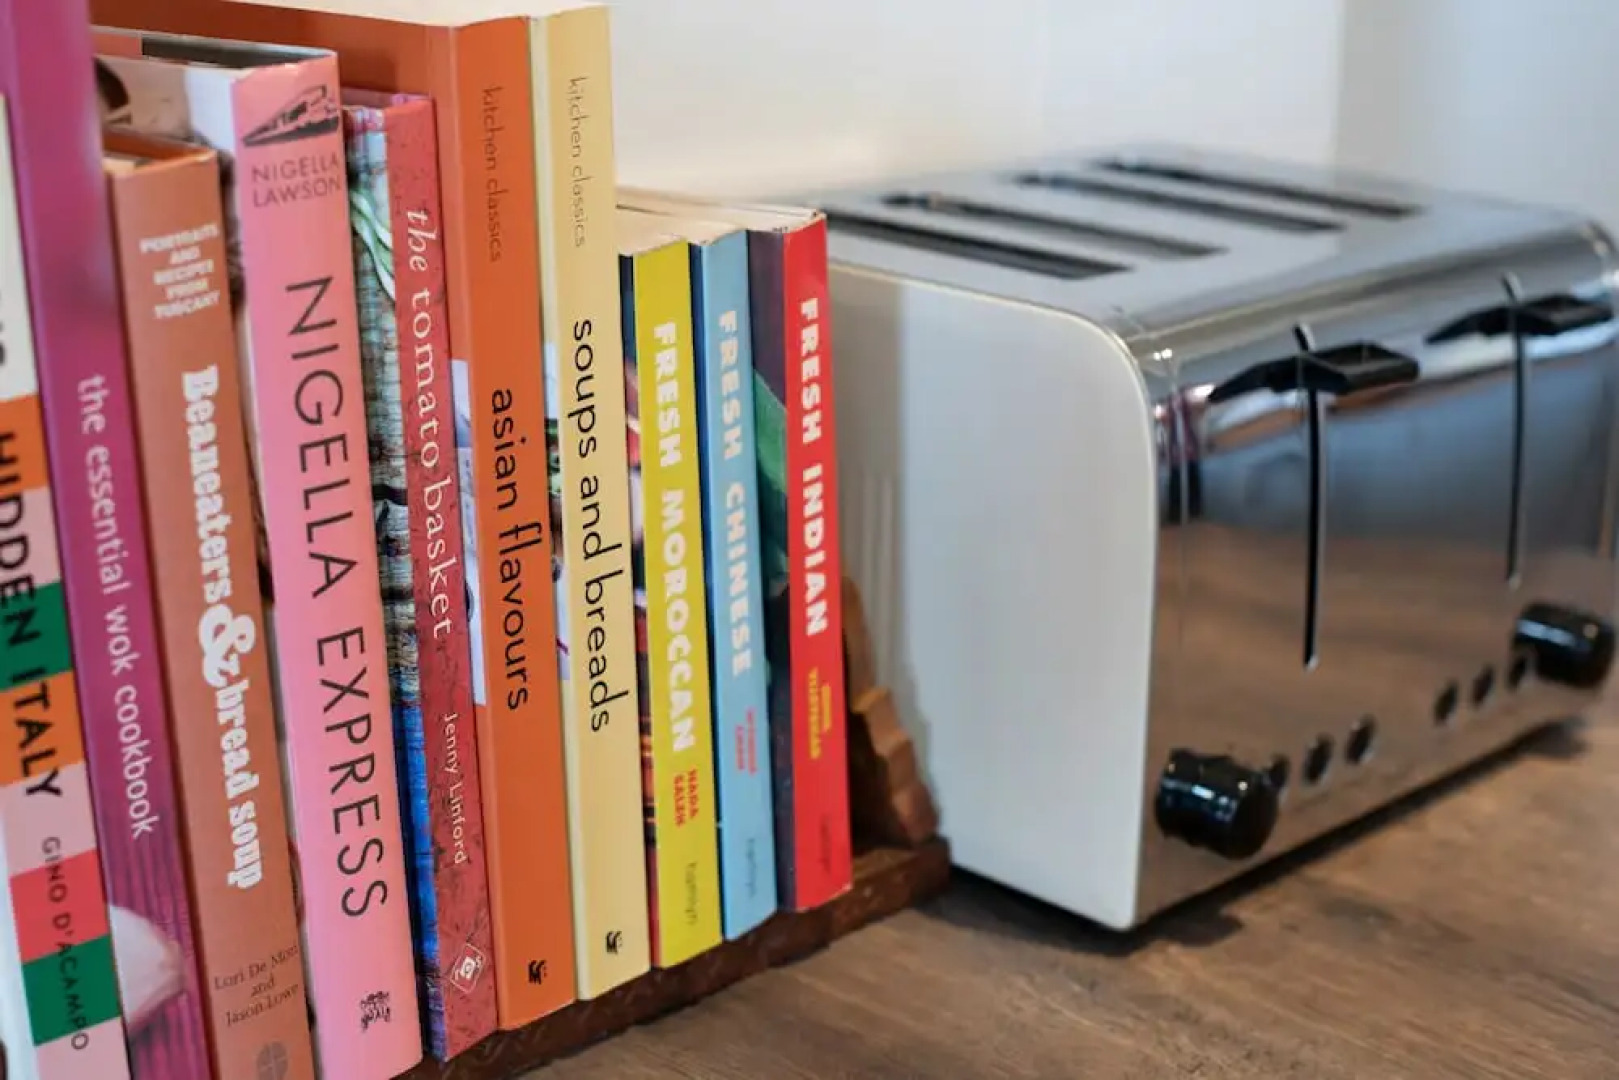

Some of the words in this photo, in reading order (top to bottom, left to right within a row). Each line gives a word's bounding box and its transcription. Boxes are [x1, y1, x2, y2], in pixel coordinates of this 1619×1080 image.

[251, 152, 339, 182] NIGELLA
[481, 85, 504, 171] kitchen
[568, 76, 588, 158] kitchen
[253, 174, 341, 208] LAWSON
[406, 207, 437, 272] the
[77, 374, 110, 434] the
[286, 276, 358, 598] NIGELLA
[412, 287, 440, 469] tomato
[567, 319, 598, 459] soups
[654, 322, 682, 467] FRESH
[718, 310, 743, 459] FRESH
[800, 298, 823, 444] FRESH
[182, 364, 232, 604] Beaneaters
[491, 388, 527, 511] asian
[580, 476, 622, 560] and
[86, 445, 131, 595] essential
[423, 476, 456, 638] basket
[725, 483, 751, 678] CHINESE
[802, 464, 828, 637] INDIAN
[105, 605, 140, 676] wok
[498, 520, 542, 710] flavours
[585, 568, 629, 732] breads
[662, 490, 696, 752] MOROCCAN
[11, 667, 62, 798] ITALY
[114, 685, 160, 839] cookbook
[214, 676, 260, 799] bread
[316, 626, 388, 917] EXPRESS
[444, 712, 459, 775] Jenny
[42, 837, 68, 902] GINO
[227, 801, 263, 890] soup
[450, 783, 467, 864] Linford
[52, 911, 90, 1051] D'ACAMPO
[250, 974, 276, 998] and
